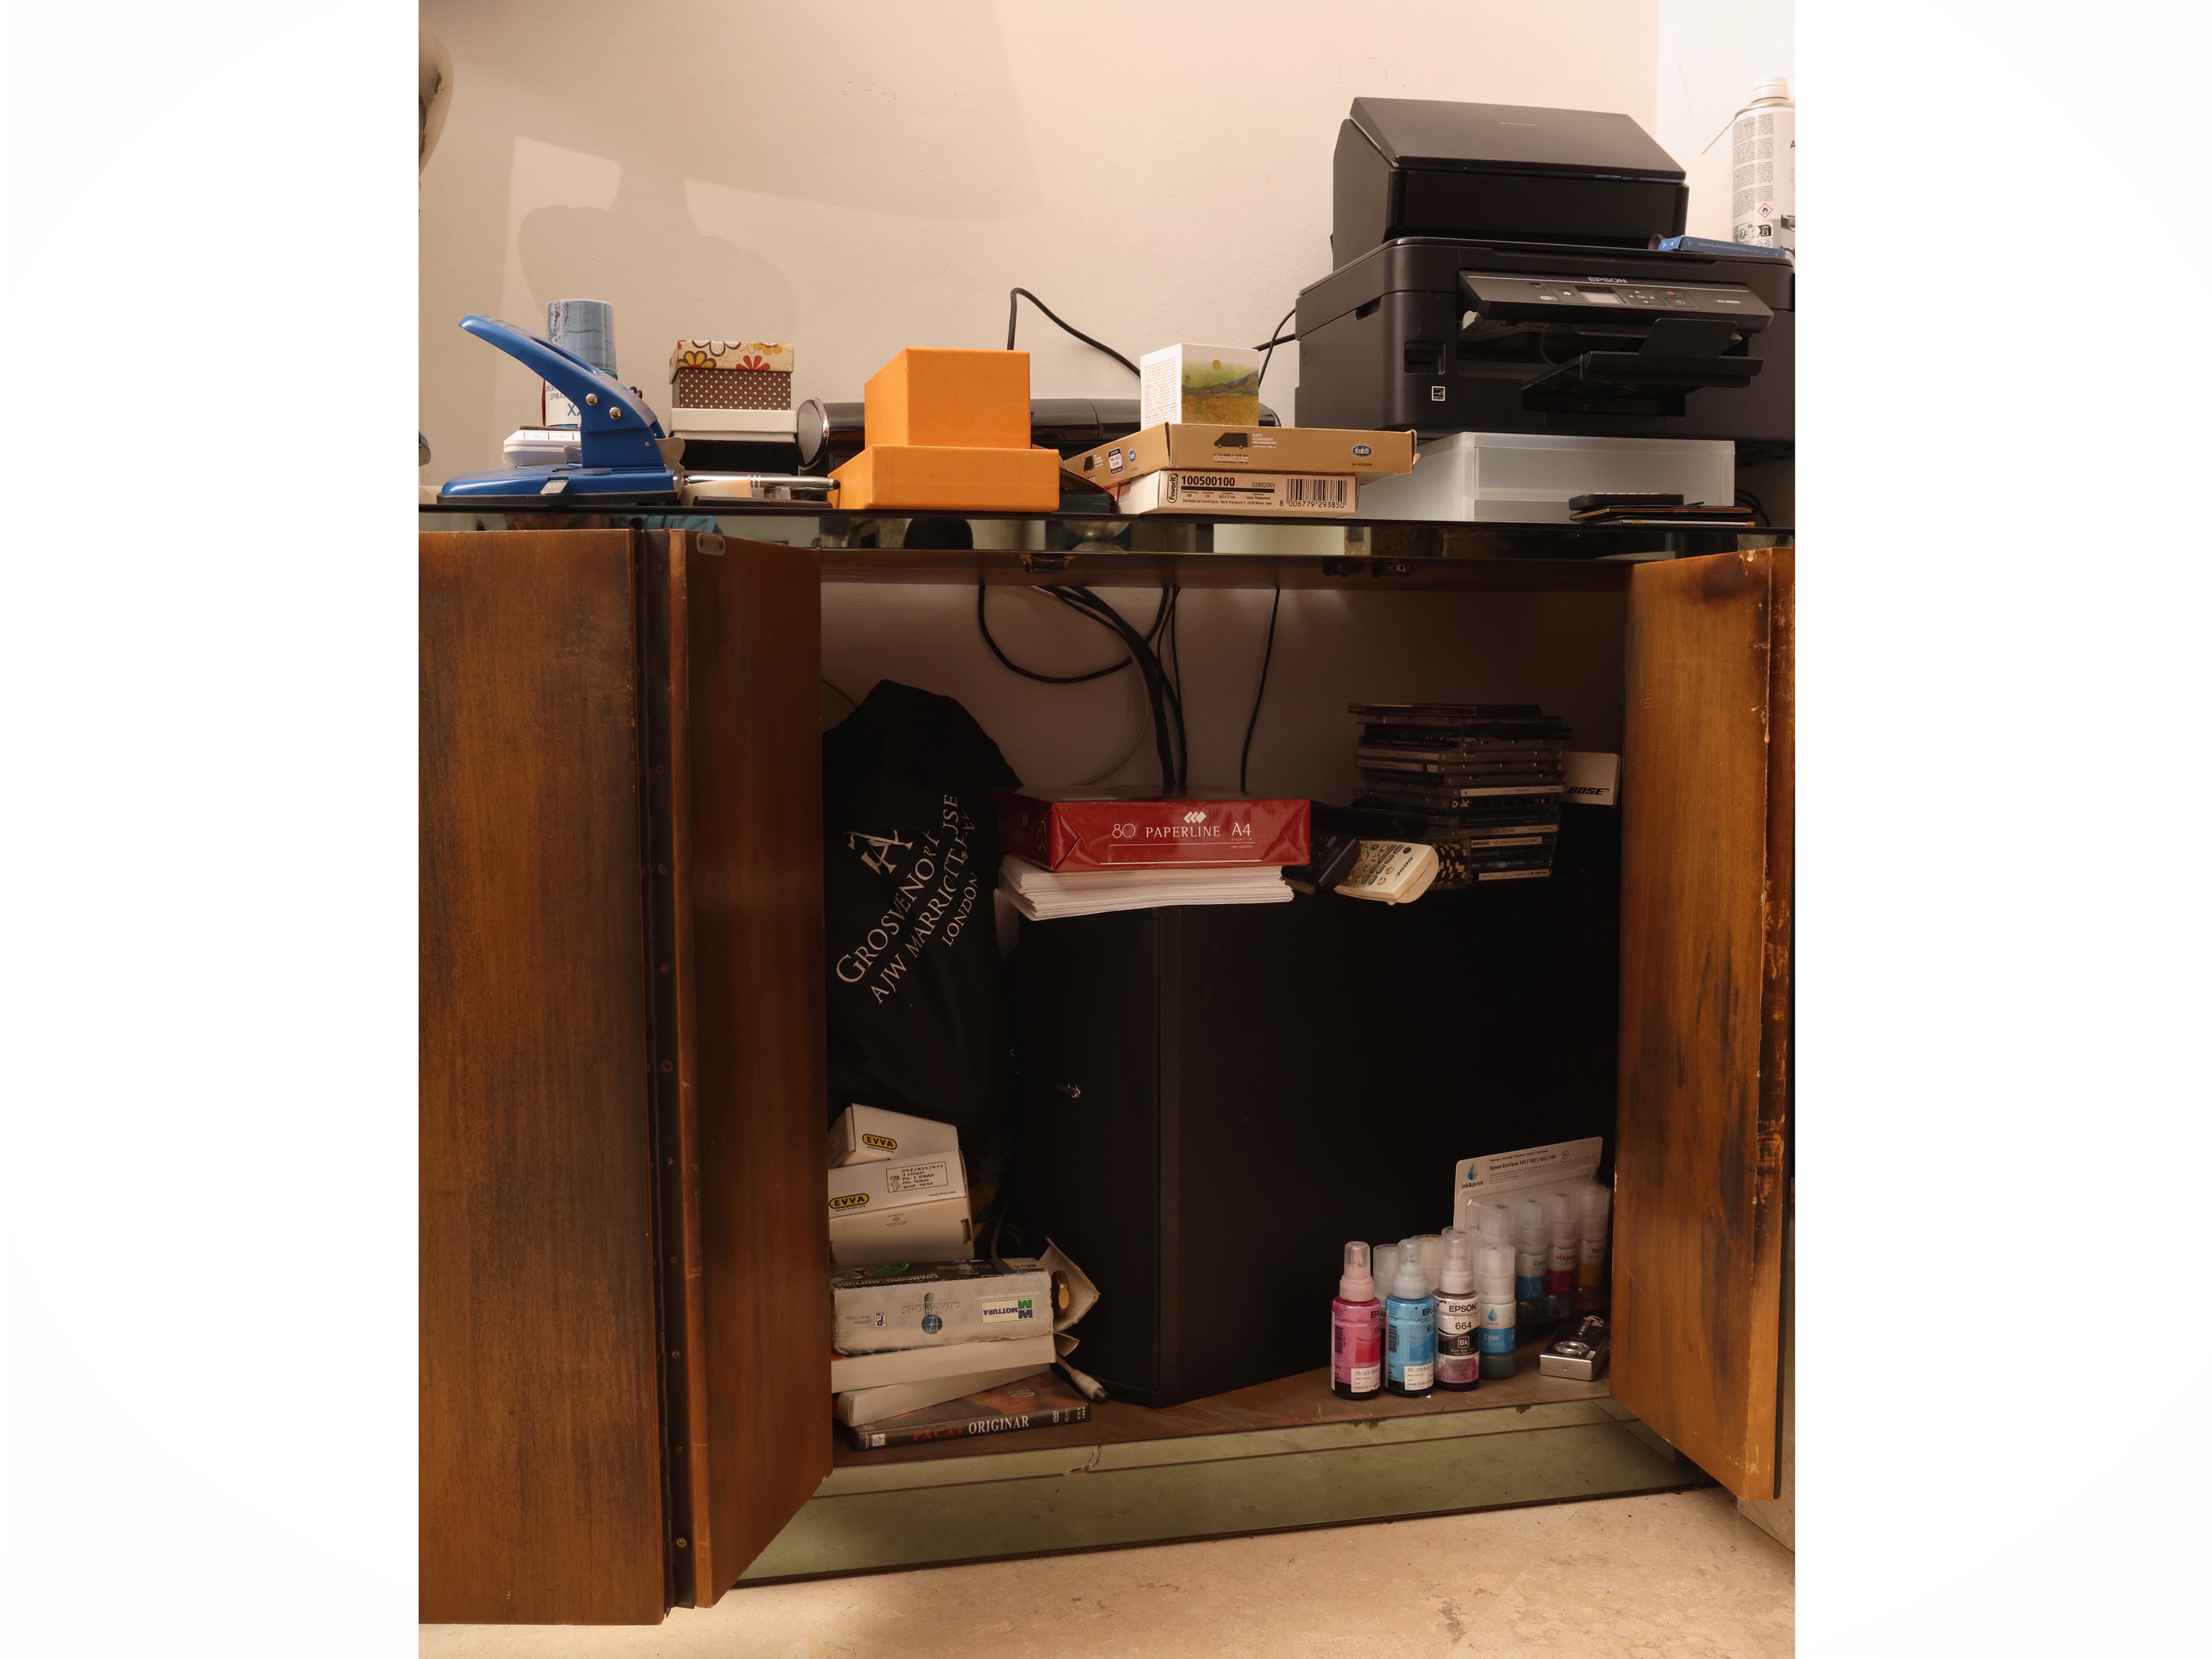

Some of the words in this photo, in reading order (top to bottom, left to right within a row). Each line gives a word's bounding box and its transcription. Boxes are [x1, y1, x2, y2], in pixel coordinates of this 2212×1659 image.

[549, 392, 566, 400] SPRA
[1181, 475, 1235, 487] 100500100
[1568, 787, 1610, 796] BOSE
[1112, 824, 1136, 839] 80
[1146, 826, 1220, 838] PAPERLINE
[1231, 823, 1252, 836] A4
[866, 1136, 894, 1148] EVVA
[1461, 1180, 1484, 1189] ink&print
[834, 1195, 866, 1207] EVVA
[902, 1301, 960, 1314] CHAMPIONS
[983, 1307, 1018, 1315] MOTTURA
[1449, 1304, 1476, 1312] EPSON
[1455, 1321, 1472, 1330] 664
[1483, 1333, 1499, 1341] Cyan
[968, 1416, 1029, 1435] ORIGINAR
